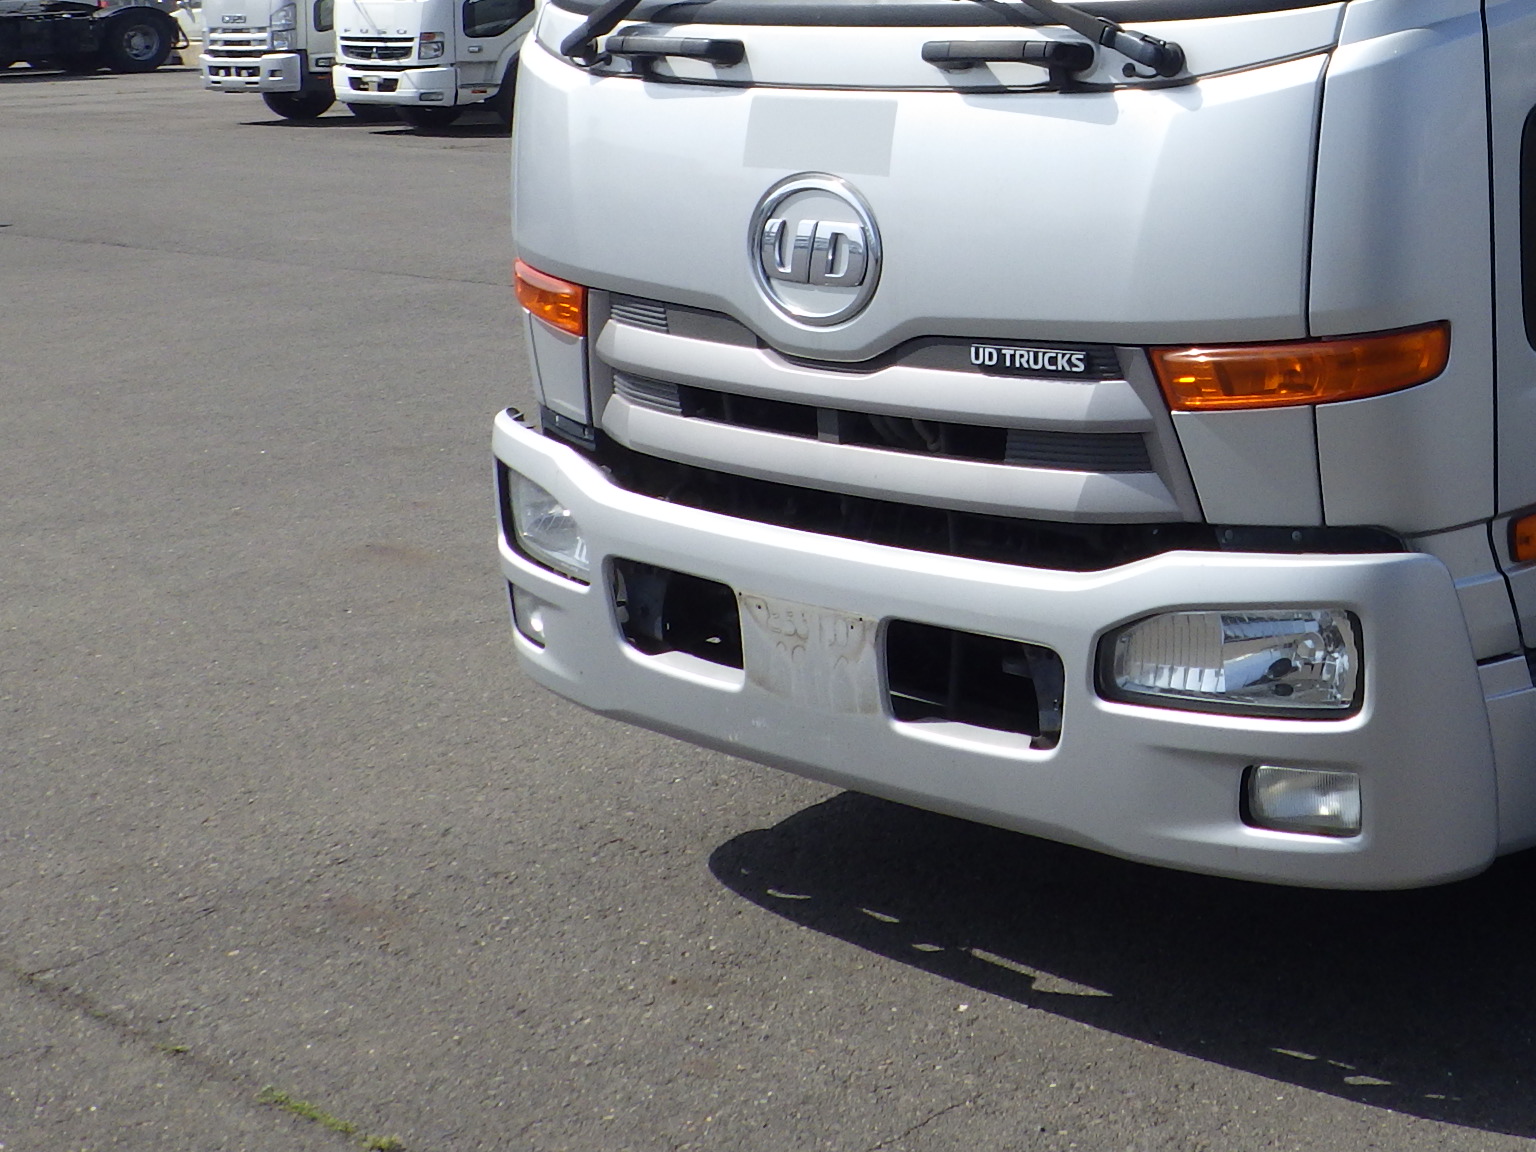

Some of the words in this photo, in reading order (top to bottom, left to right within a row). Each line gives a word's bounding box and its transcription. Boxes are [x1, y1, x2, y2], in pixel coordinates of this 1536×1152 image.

[761, 218, 868, 288] UD
[970, 346, 998, 366] UD
[1001, 349, 1085, 372] TRUCKS
